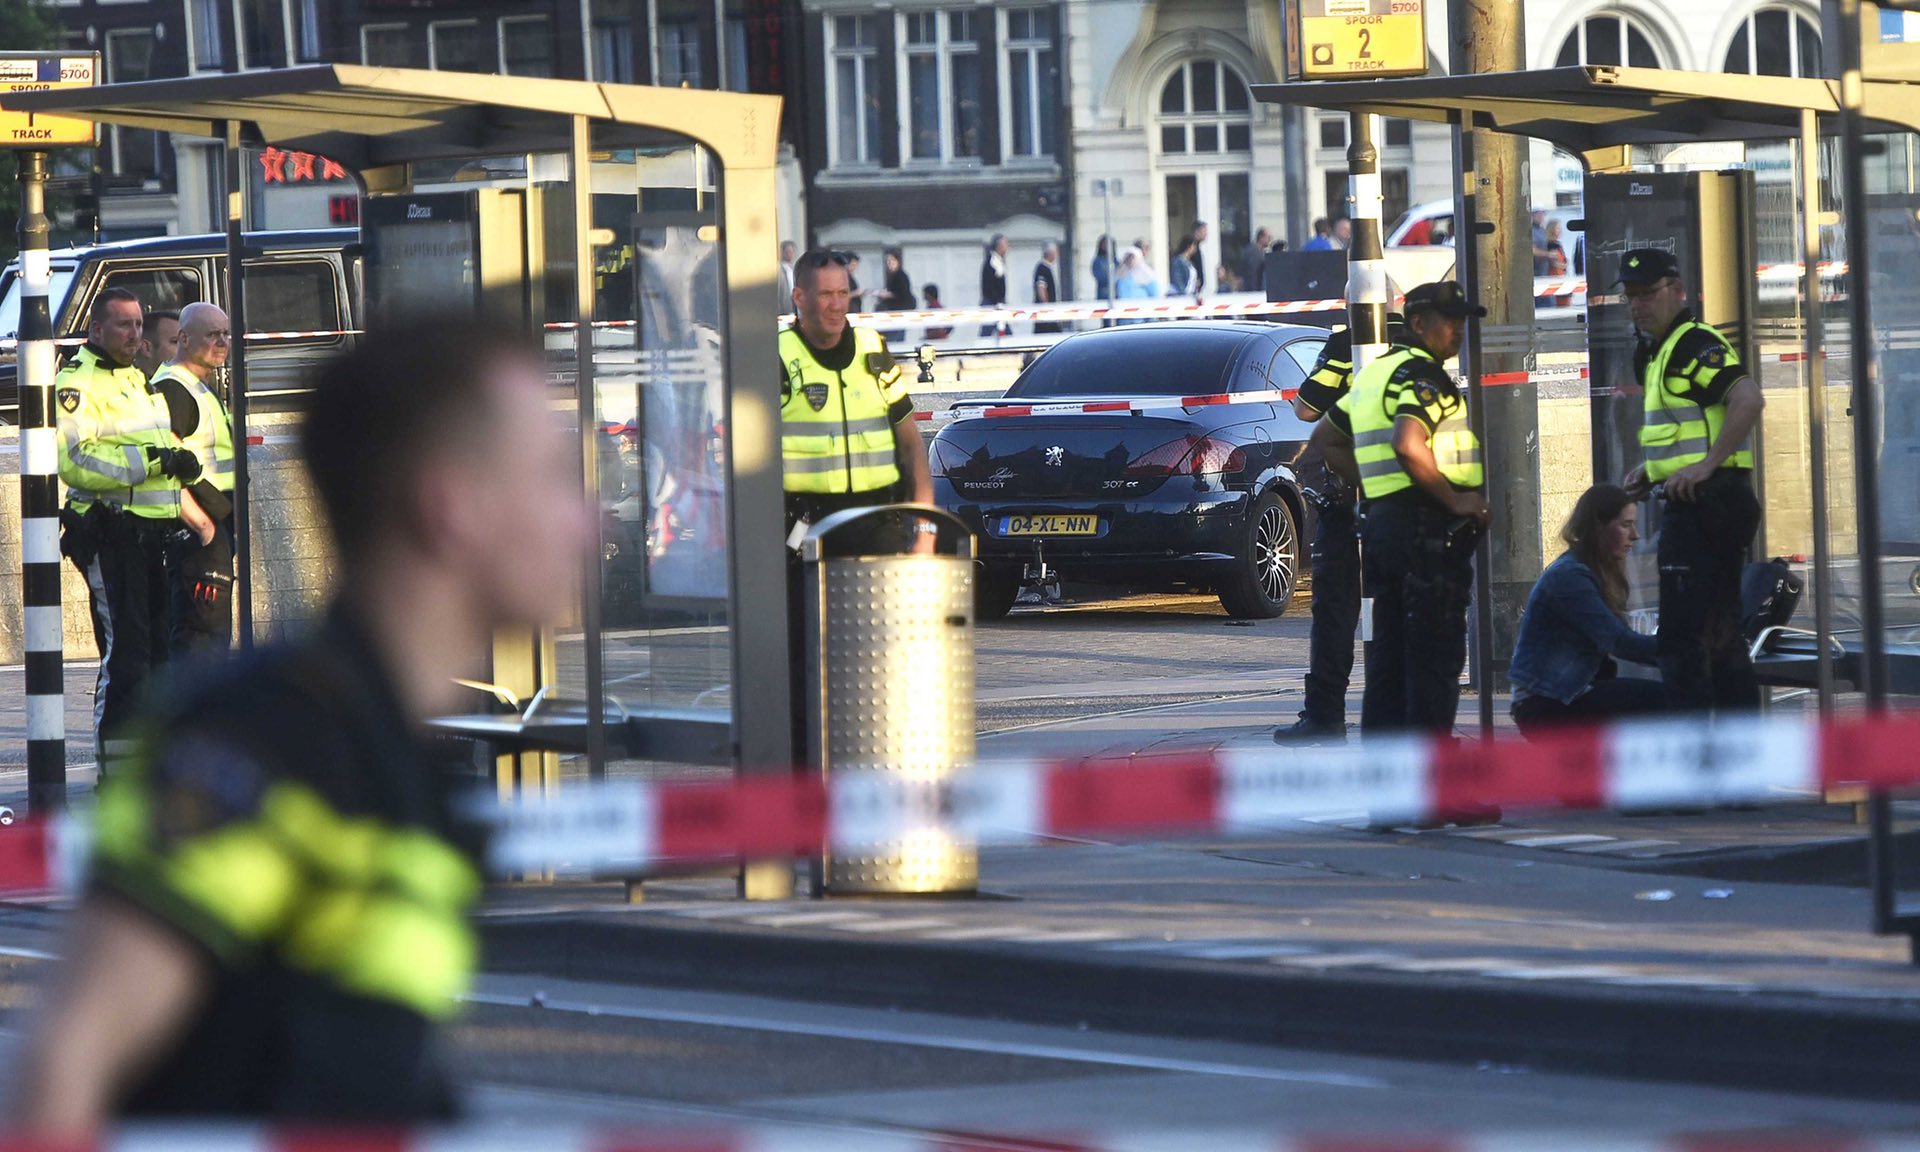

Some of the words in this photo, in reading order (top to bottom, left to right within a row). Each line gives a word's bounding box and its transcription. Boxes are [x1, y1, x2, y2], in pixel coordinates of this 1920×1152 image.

[1392, 3, 1419, 12] 5700
[1345, 15, 1383, 25] SPOOR
[1358, 28, 1371, 58] 2
[1348, 60, 1385, 70] TRACK
[61, 69, 90, 79] 5700
[12, 129, 52, 139] TRACK
[964, 481, 1005, 489] PEUGEOT
[1102, 480, 1124, 489] 307
[1011, 517, 1090, 533] 04-XL-NN
